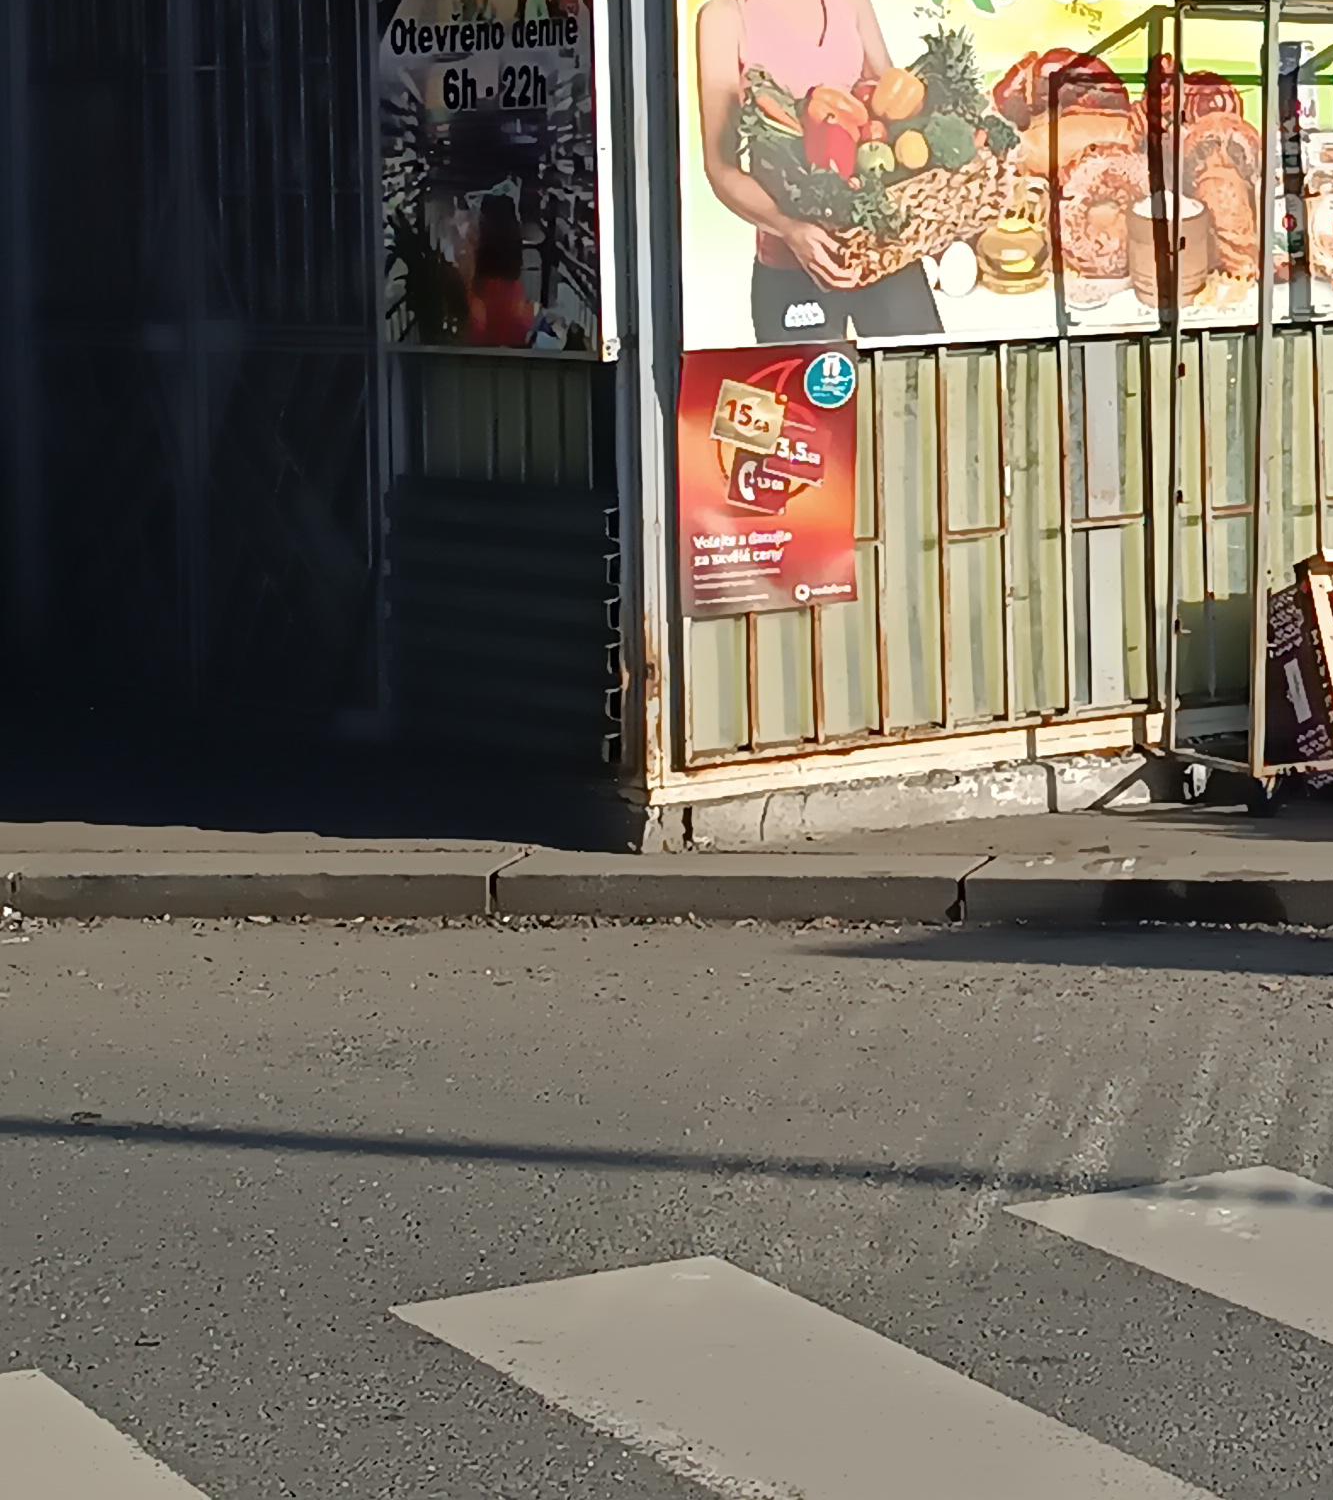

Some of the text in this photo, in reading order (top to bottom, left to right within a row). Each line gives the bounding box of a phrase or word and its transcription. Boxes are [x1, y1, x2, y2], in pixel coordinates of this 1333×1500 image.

[390, 13, 578, 55] Otevřeno denně
[443, 68, 477, 109] 6h
[502, 66, 547, 108] 22h
[725, 399, 752, 426] 15
